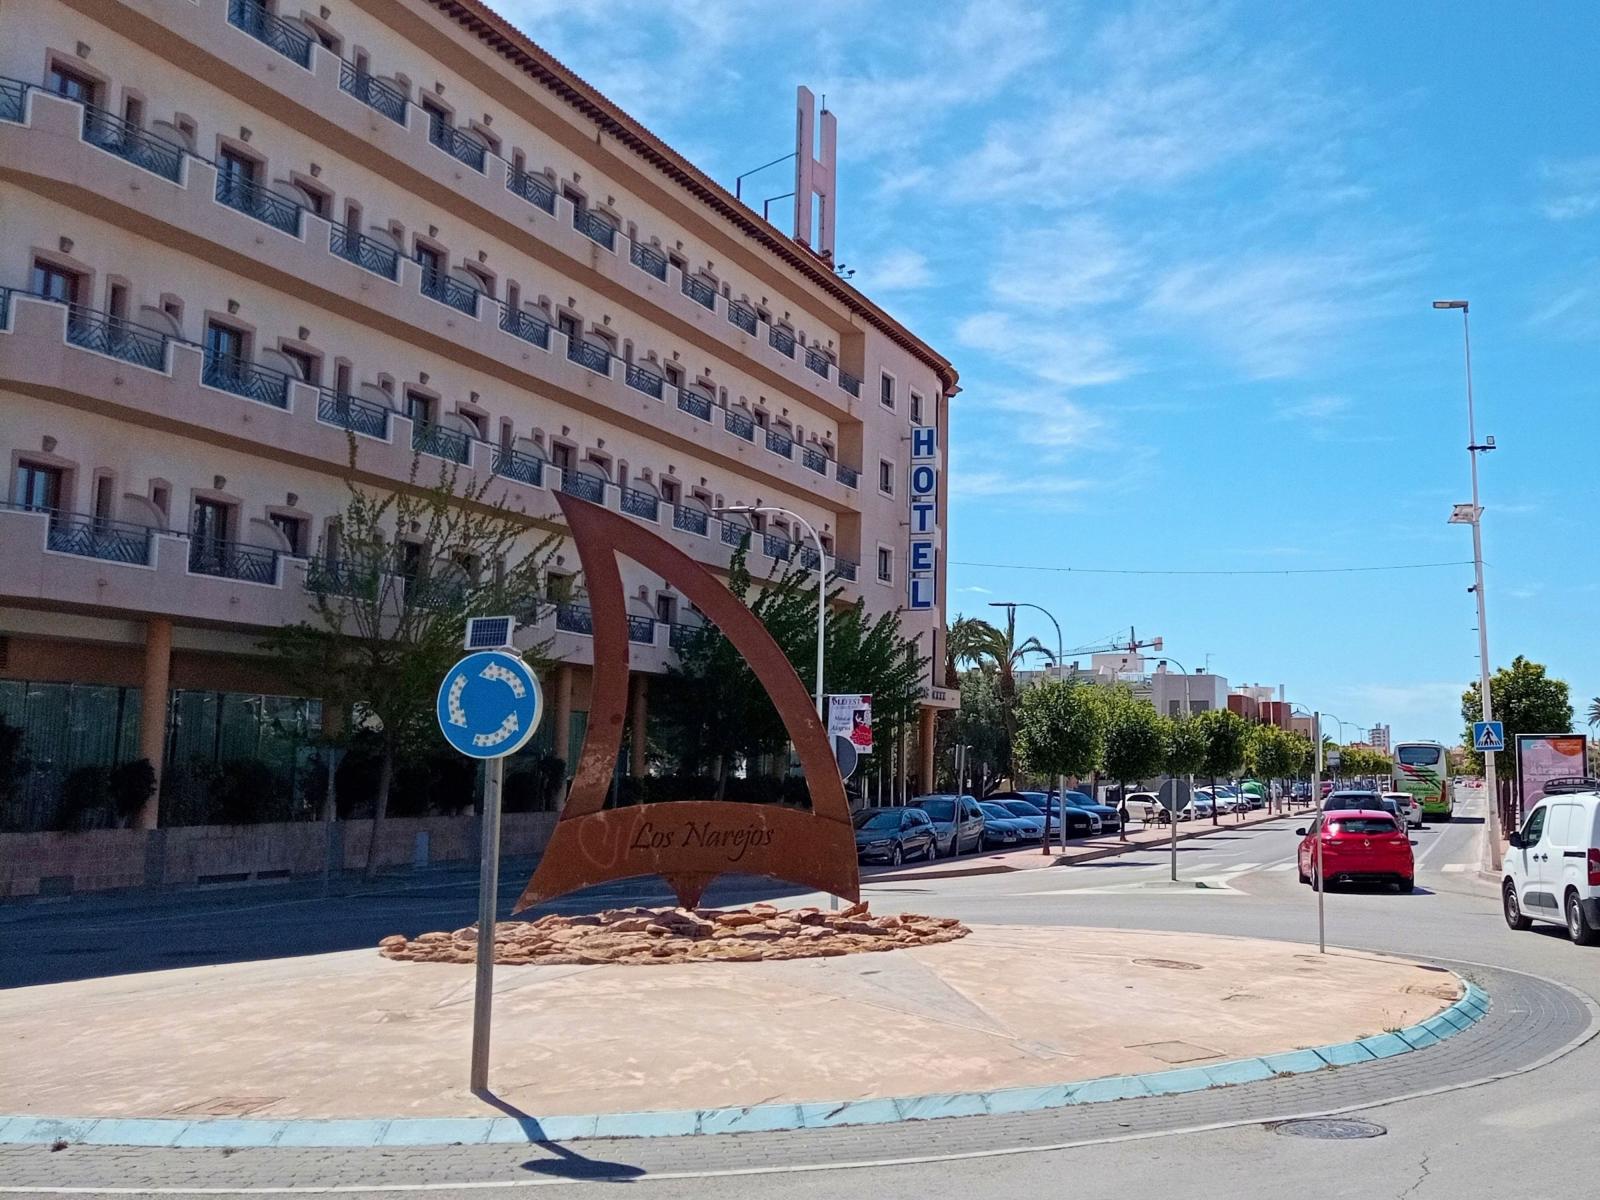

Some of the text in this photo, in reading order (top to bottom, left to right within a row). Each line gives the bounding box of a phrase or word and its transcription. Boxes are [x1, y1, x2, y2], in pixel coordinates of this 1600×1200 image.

[911, 429, 935, 608] HOTEL
[630, 821, 675, 850] Los
[680, 820, 775, 862] Narejos
